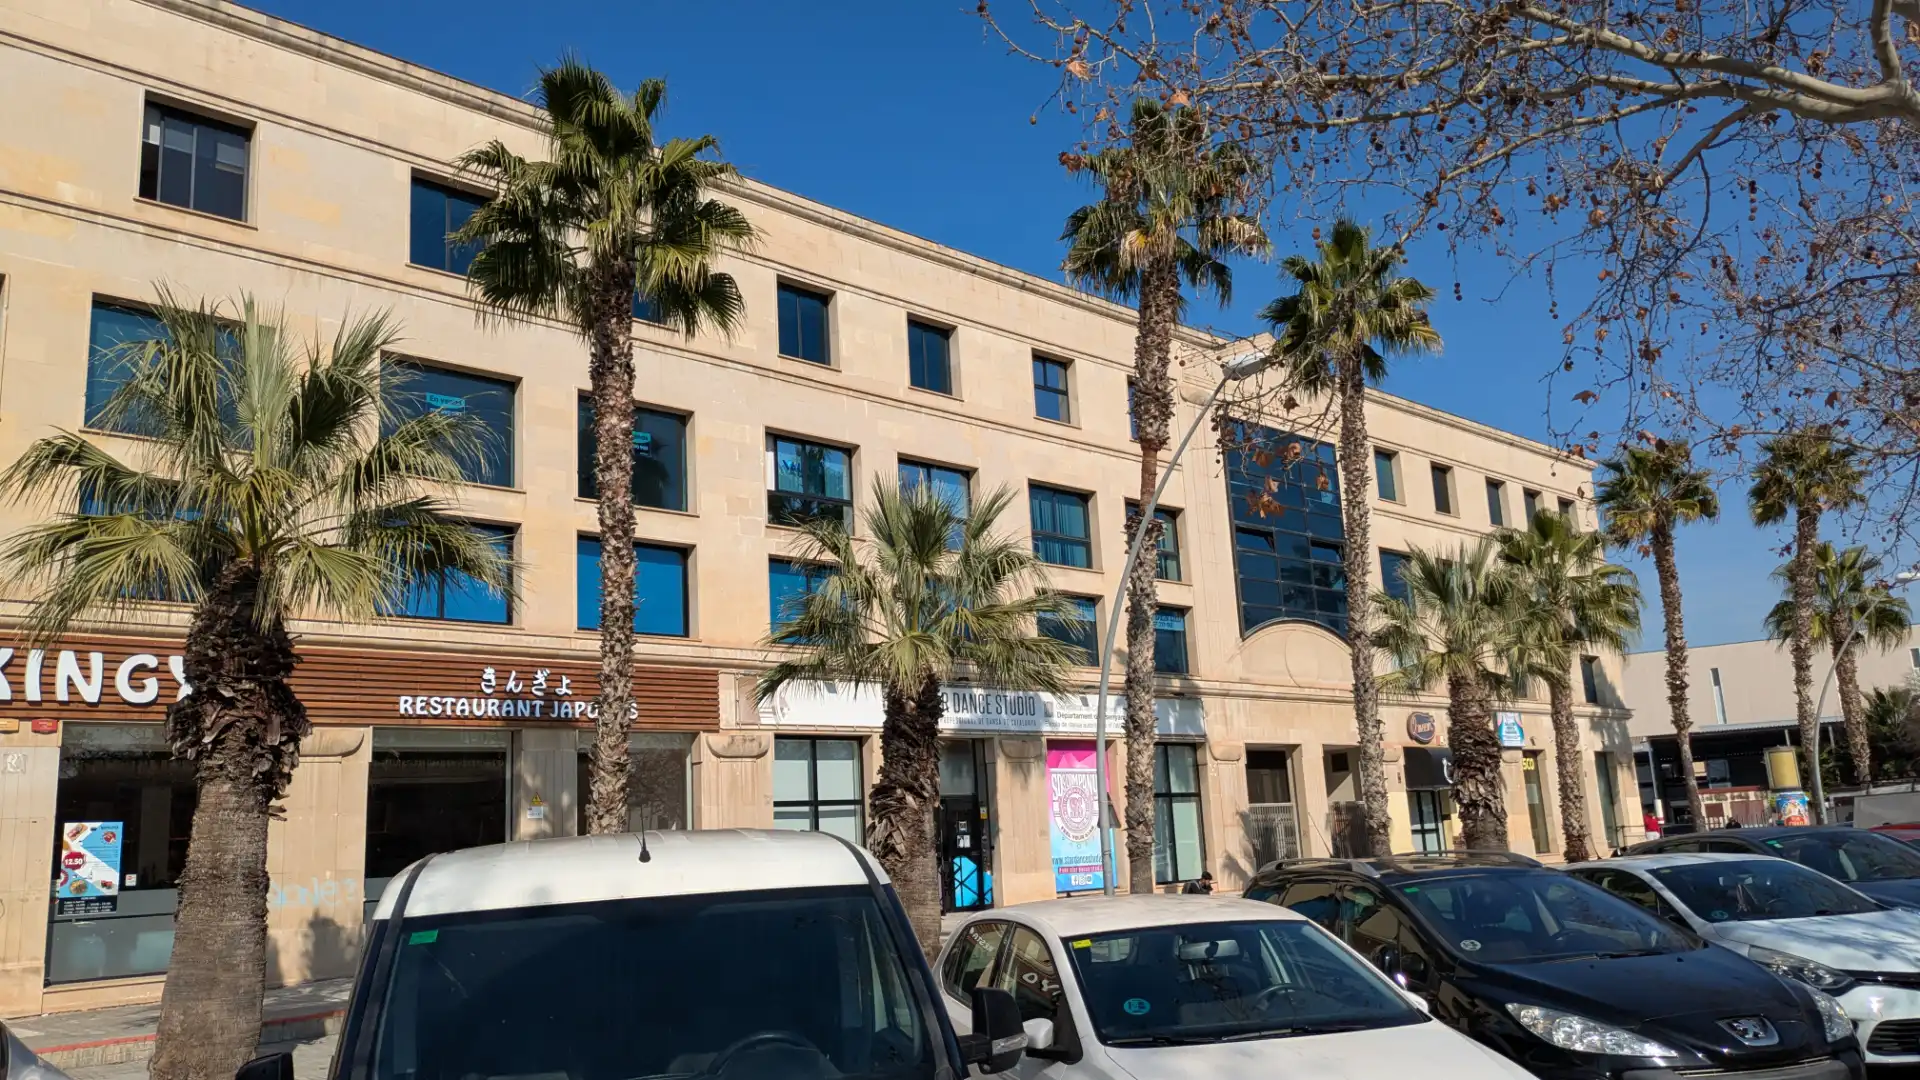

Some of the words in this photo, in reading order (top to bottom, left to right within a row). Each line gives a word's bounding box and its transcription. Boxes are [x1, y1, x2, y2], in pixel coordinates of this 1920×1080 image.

[399, 695, 544, 718] RESTAURANT
[953, 692, 992, 715] DANCE
[996, 694, 1036, 717] STUDIO
